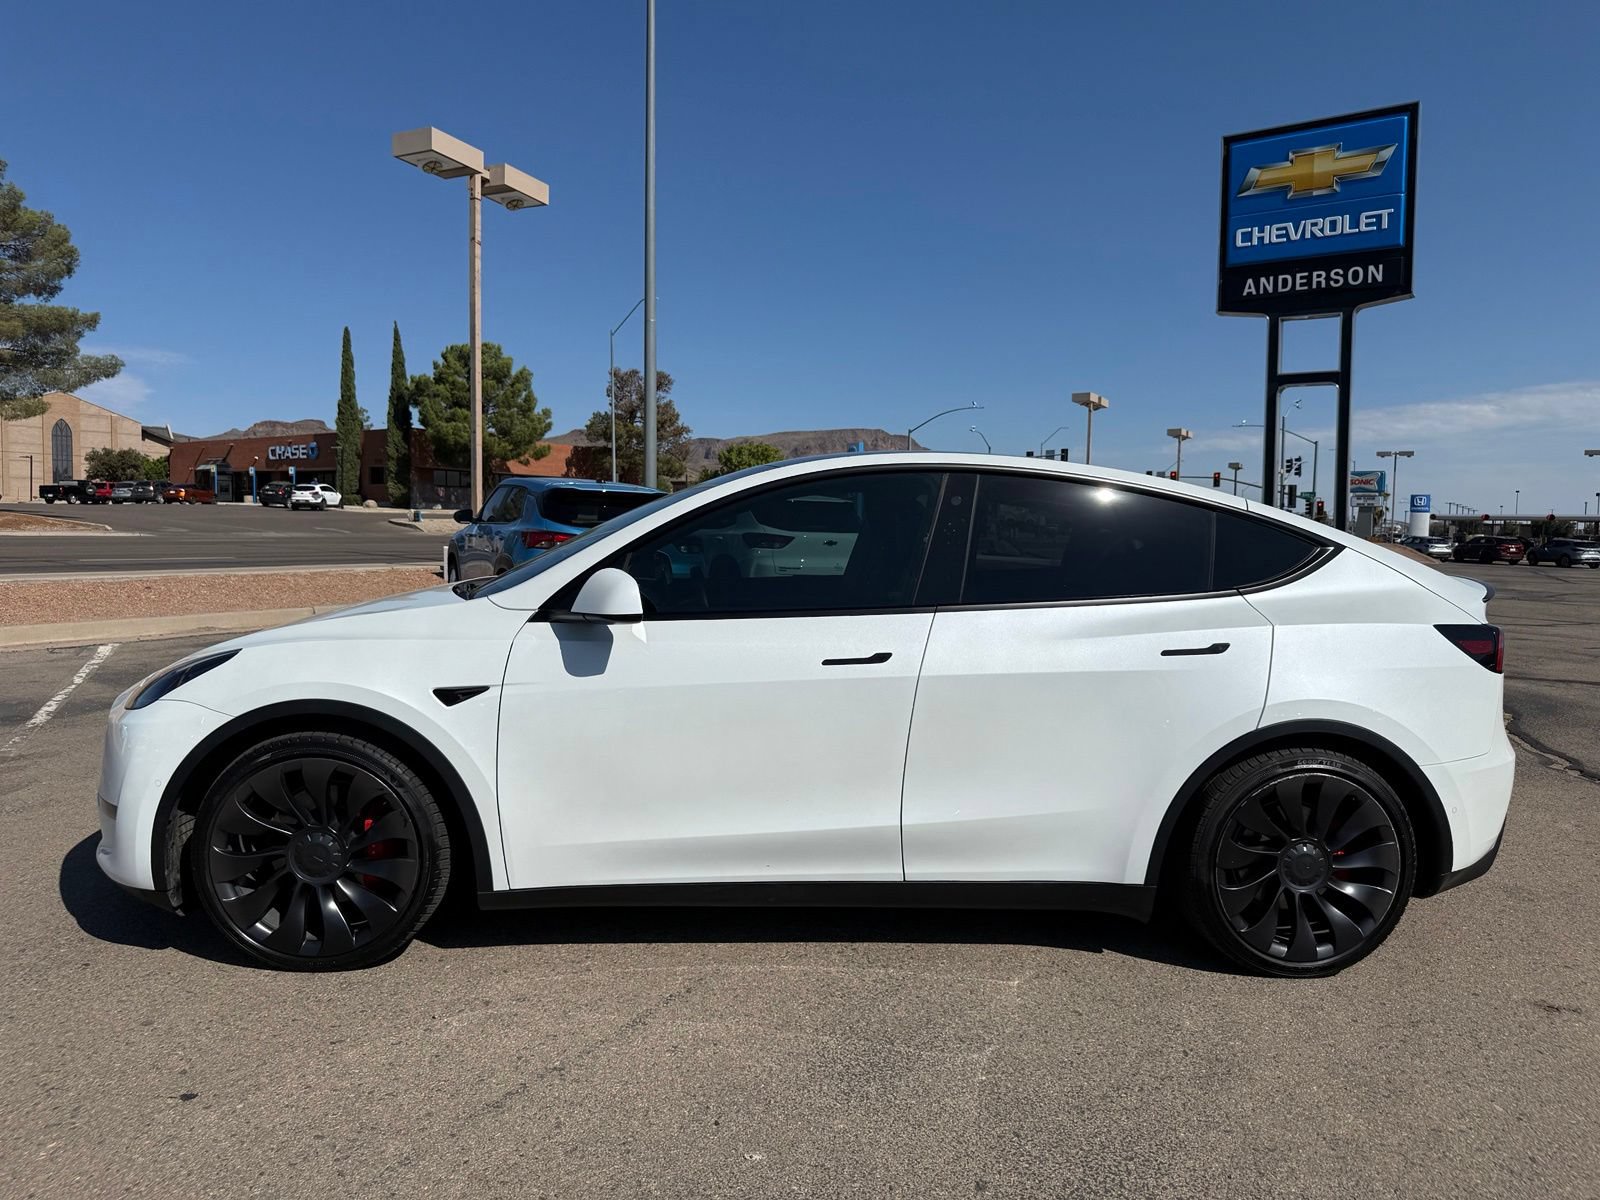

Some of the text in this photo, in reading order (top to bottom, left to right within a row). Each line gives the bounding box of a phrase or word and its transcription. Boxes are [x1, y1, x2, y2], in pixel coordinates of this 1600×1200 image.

[1236, 208, 1394, 247] CHEVROLET
[1242, 264, 1384, 296] ANDERSON
[268, 444, 307, 460] CHASE
[1350, 478, 1374, 486] SONIC
